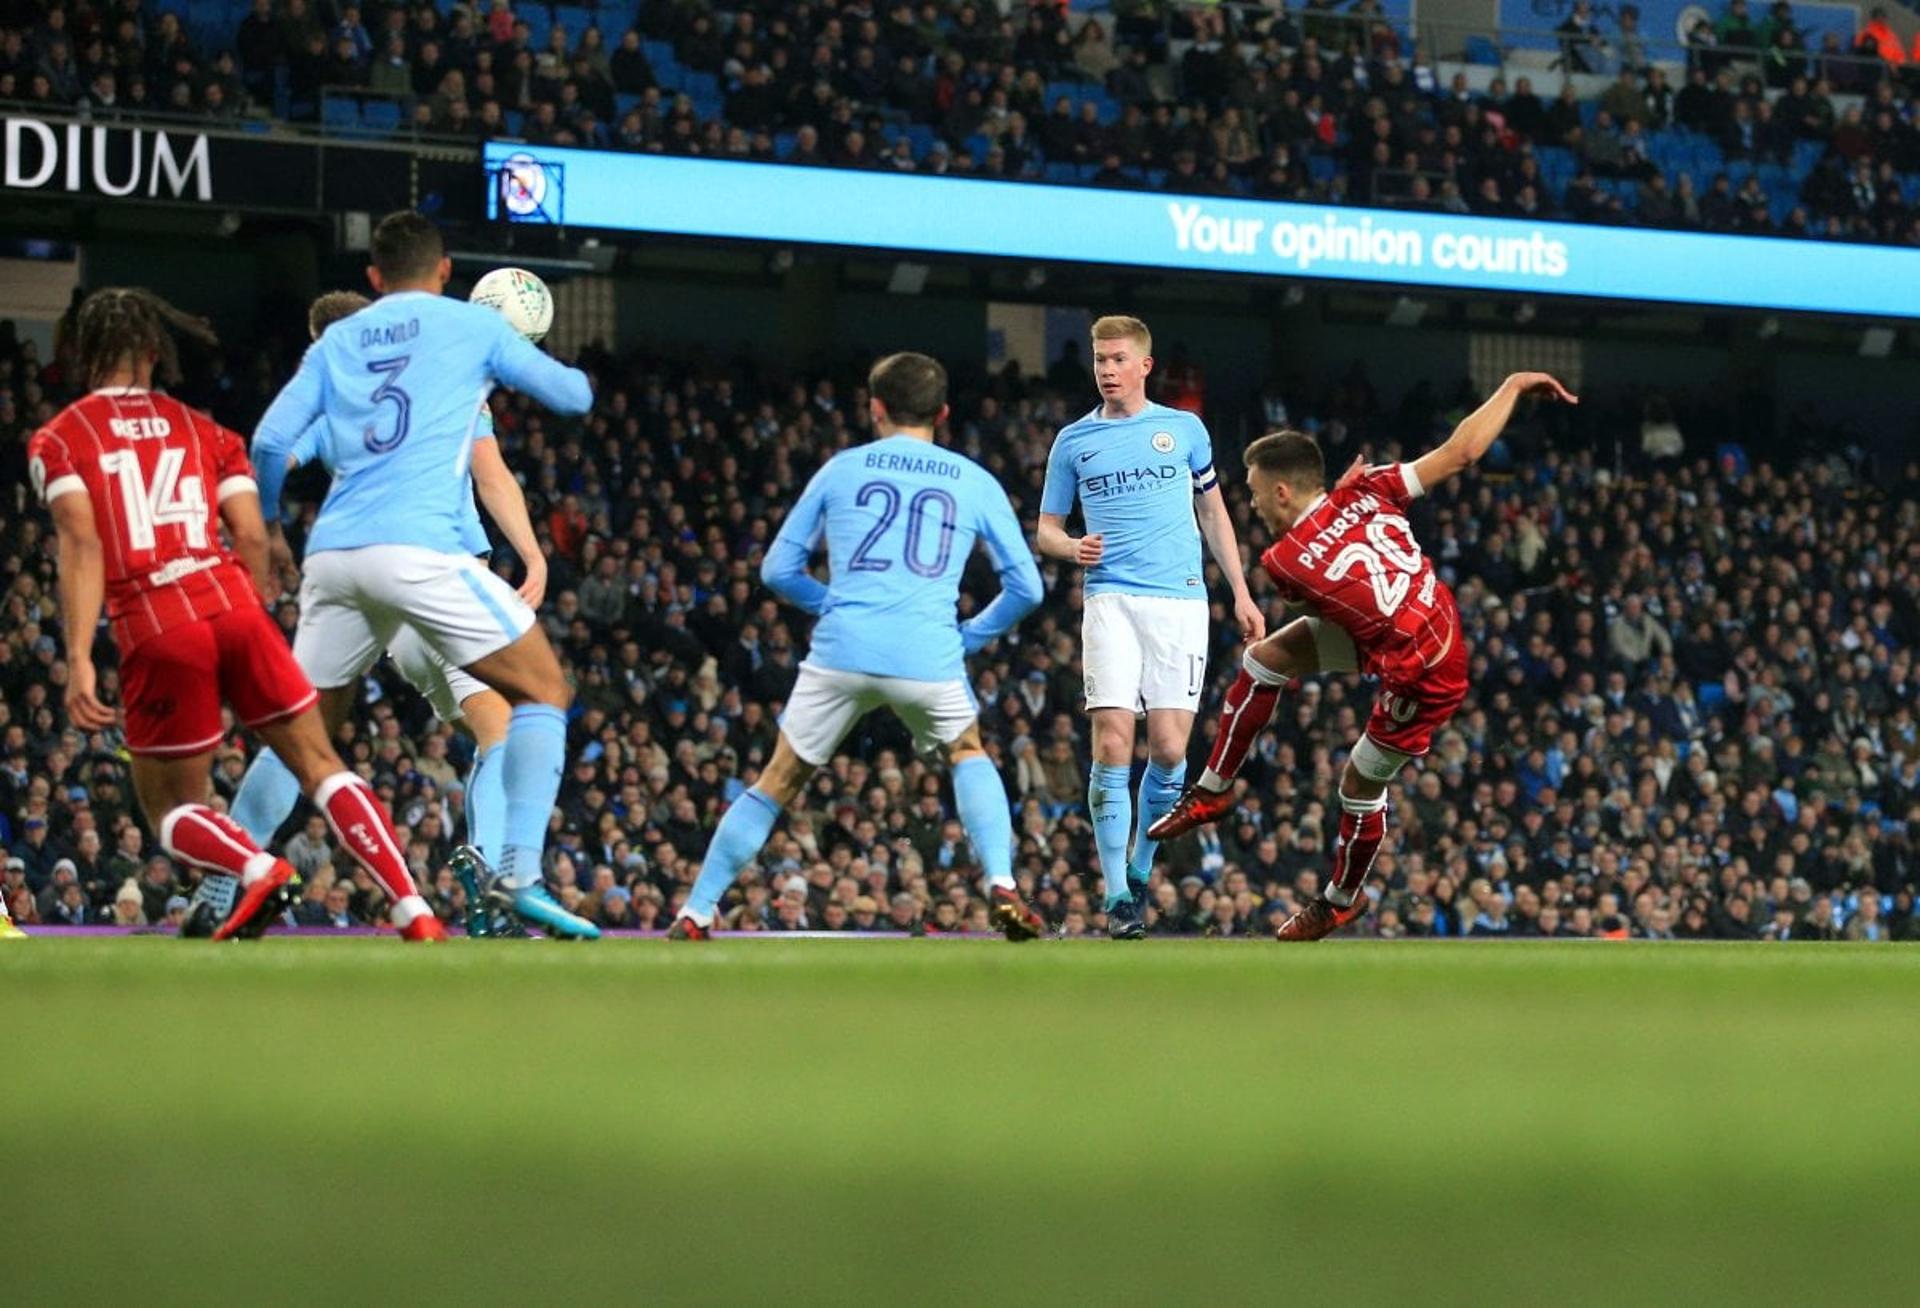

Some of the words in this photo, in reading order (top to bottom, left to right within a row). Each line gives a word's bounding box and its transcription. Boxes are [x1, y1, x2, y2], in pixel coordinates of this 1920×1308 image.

[5, 117, 213, 201] DIUM
[1168, 202, 1263, 254] Your
[1272, 213, 1422, 269] opinion
[1431, 227, 1568, 277] counts
[360, 317, 421, 349] DANILO
[109, 416, 172, 441] REID
[364, 355, 412, 455] 3
[865, 452, 961, 480] BERNARDO
[1085, 465, 1177, 492] ETIHAD
[1102, 480, 1163, 497] AIRWAYS
[98, 447, 208, 550] 14
[848, 480, 957, 578] 20
[1297, 493, 1381, 570] PATERSON
[1323, 512, 1422, 617] 20
[1186, 653, 1204, 689] 17
[1096, 813, 1118, 823] CITY
